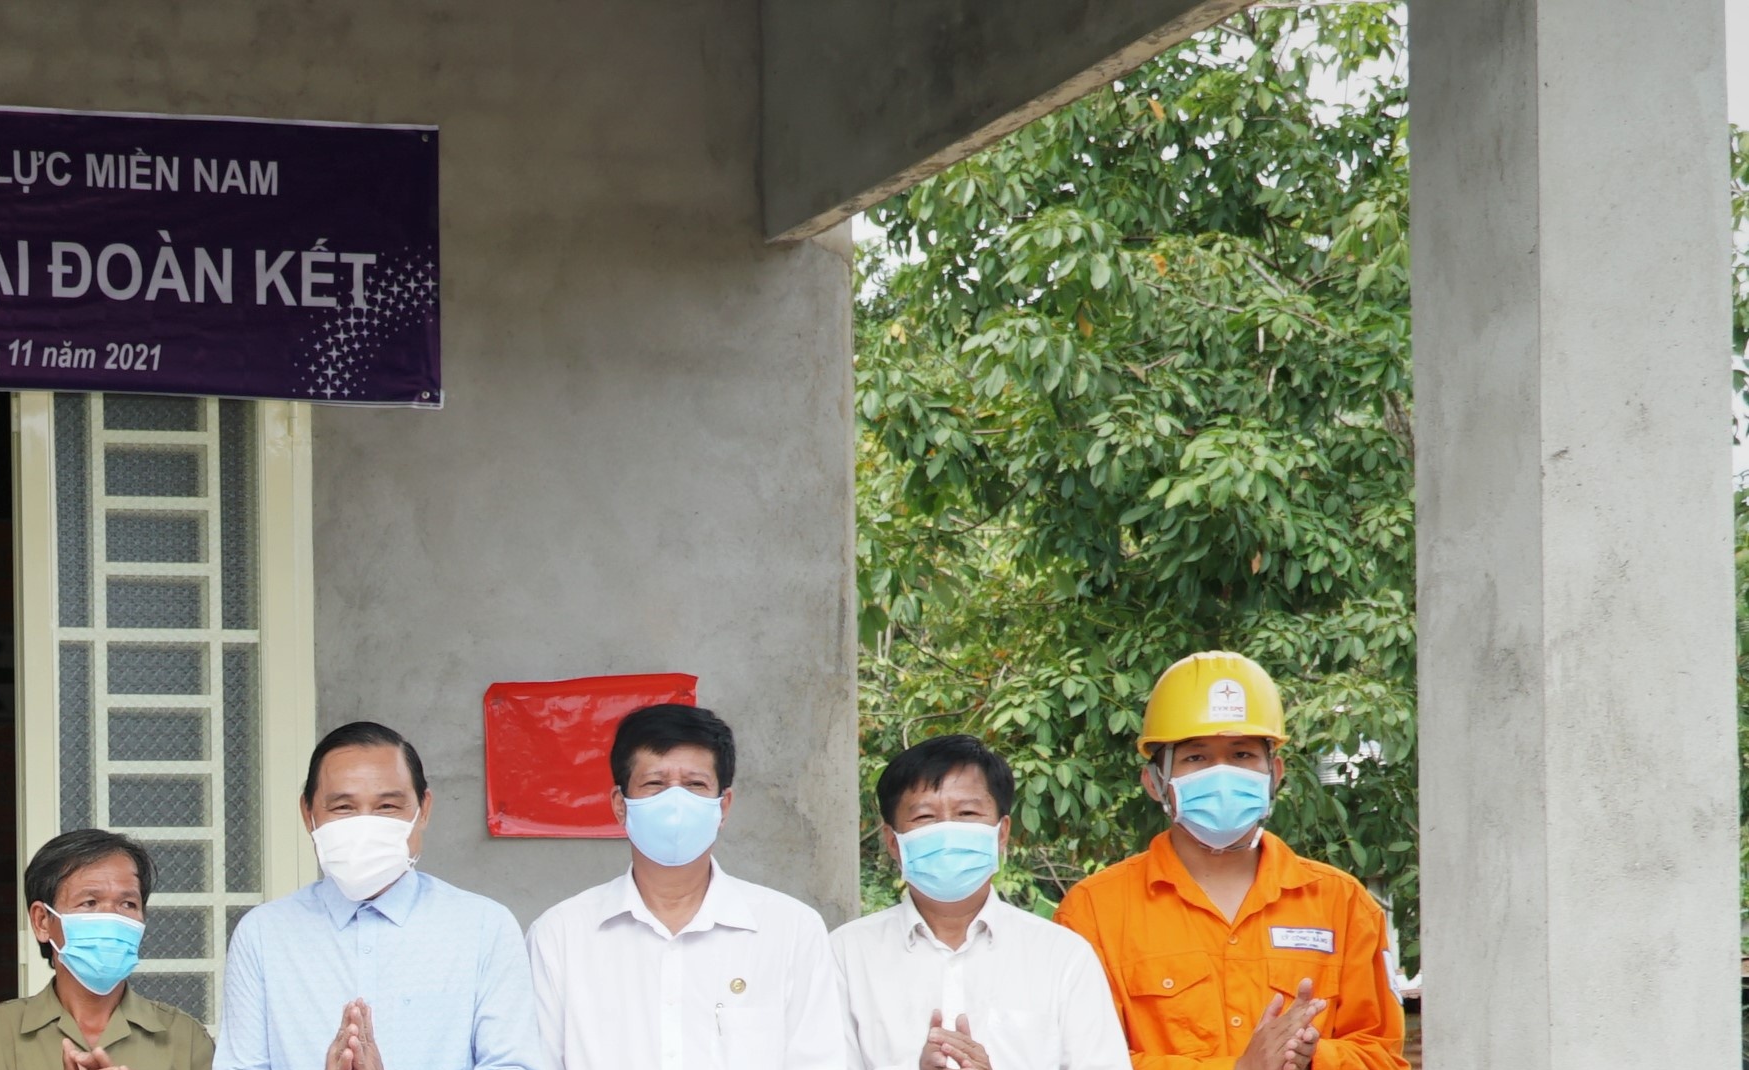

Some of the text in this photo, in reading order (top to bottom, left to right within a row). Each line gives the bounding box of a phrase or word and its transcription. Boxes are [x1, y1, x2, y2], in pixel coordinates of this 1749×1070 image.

[86, 146, 179, 192] MIỀN
[194, 158, 279, 196] NAM
[48, 230, 233, 305] ĐOÀN
[256, 238, 377, 308] KẾT
[8, 339, 33, 366] 11
[41, 342, 96, 369] năm
[104, 343, 162, 372] 2021
